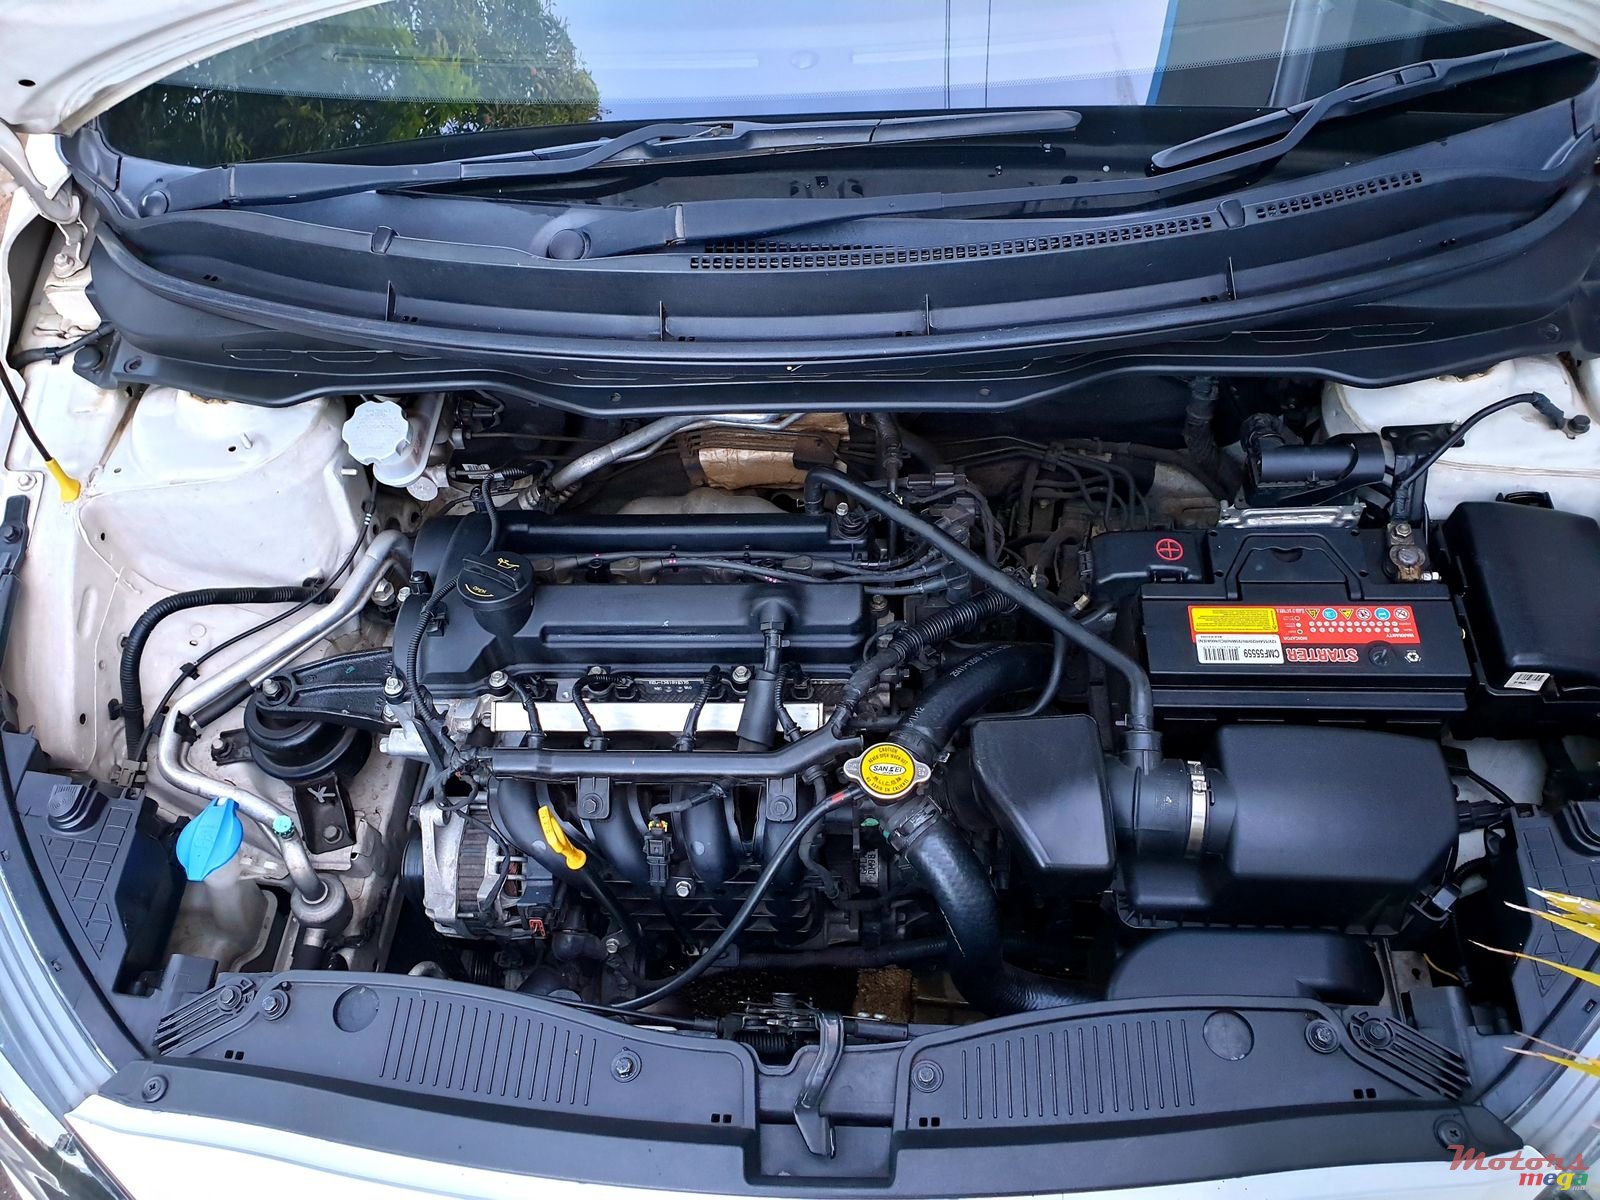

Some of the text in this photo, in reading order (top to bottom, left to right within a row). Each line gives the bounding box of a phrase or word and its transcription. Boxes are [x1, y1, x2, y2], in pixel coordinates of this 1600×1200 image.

[472, 585, 487, 594] OPEN
[1243, 648, 1280, 658] CMF55559
[1286, 648, 1359, 662] STARTER
